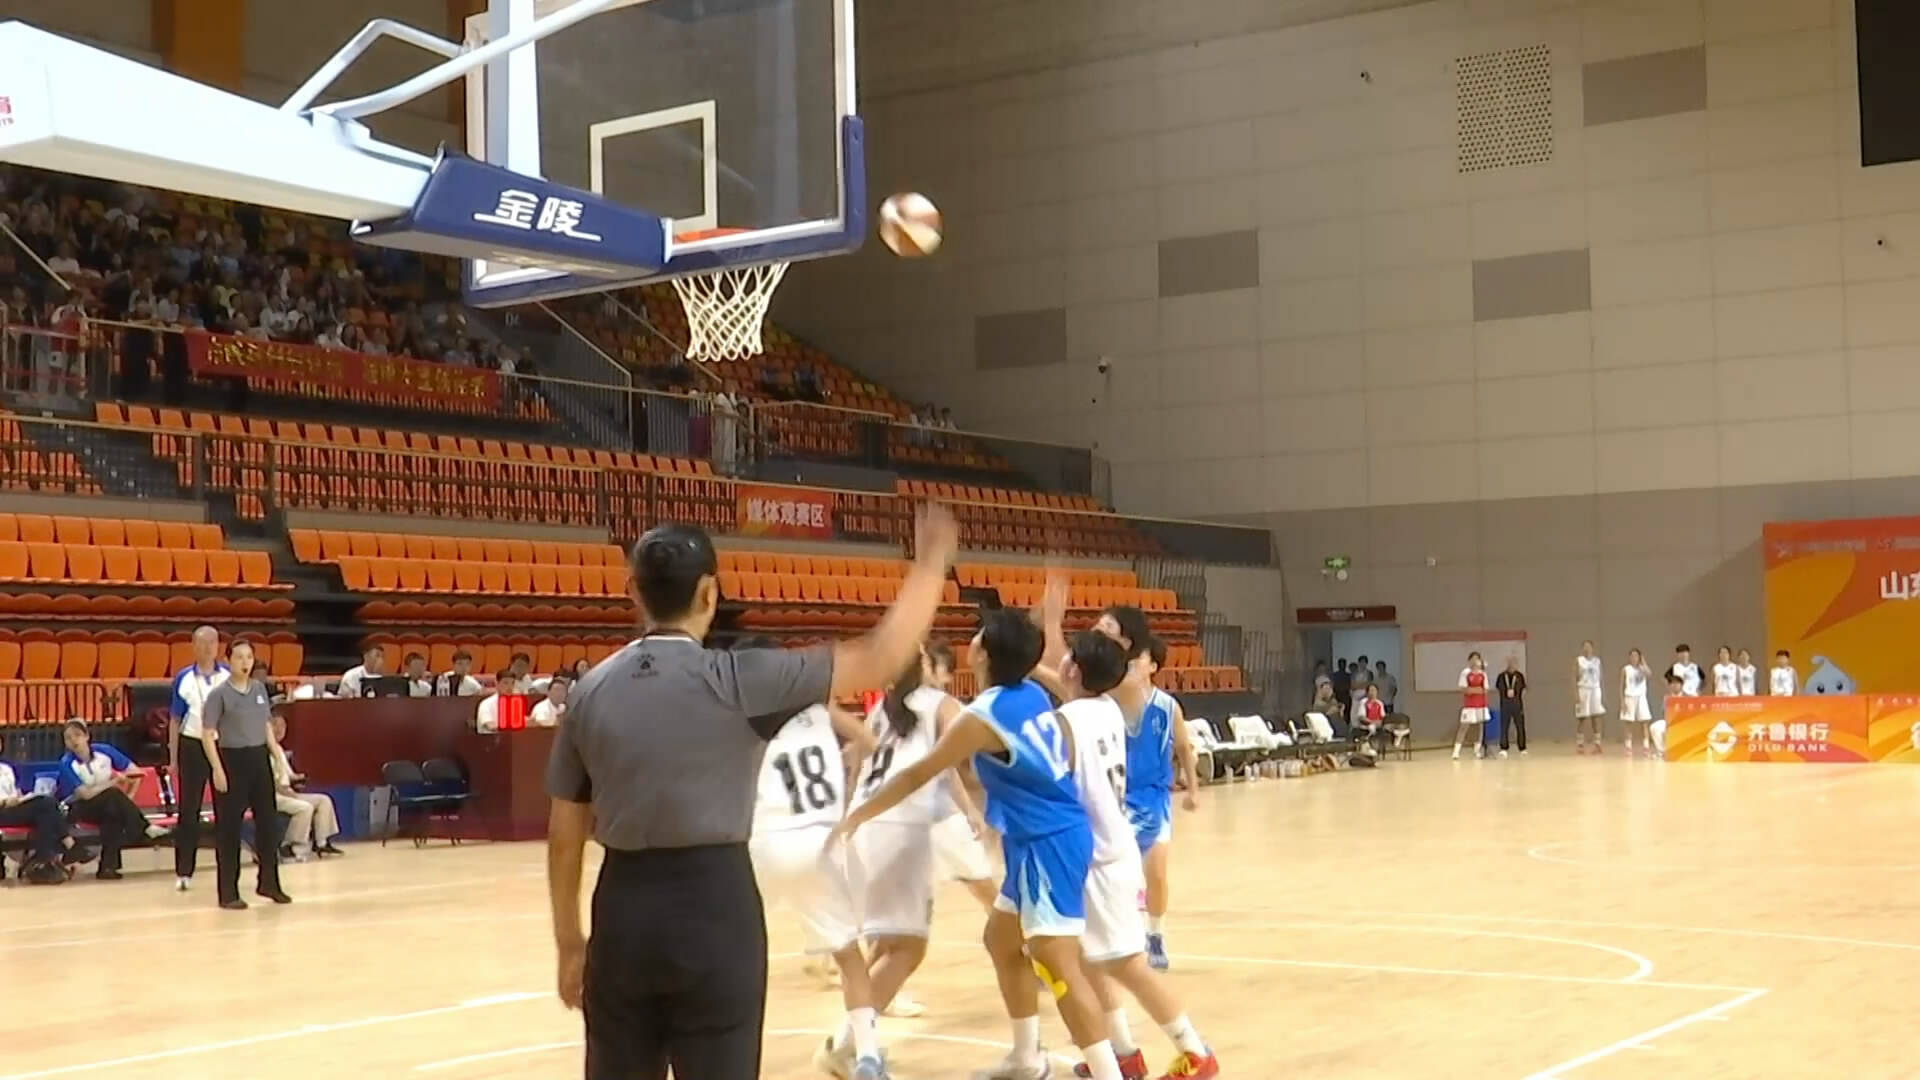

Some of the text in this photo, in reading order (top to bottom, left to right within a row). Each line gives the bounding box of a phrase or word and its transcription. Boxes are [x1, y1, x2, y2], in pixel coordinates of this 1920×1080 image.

[474, 189, 601, 241] 金陵
[746, 498, 825, 528] 媒体观赛区
[1021, 711, 1069, 781] 12
[1748, 722, 1829, 741] 齐鲁银行
[772, 745, 837, 814] 18
